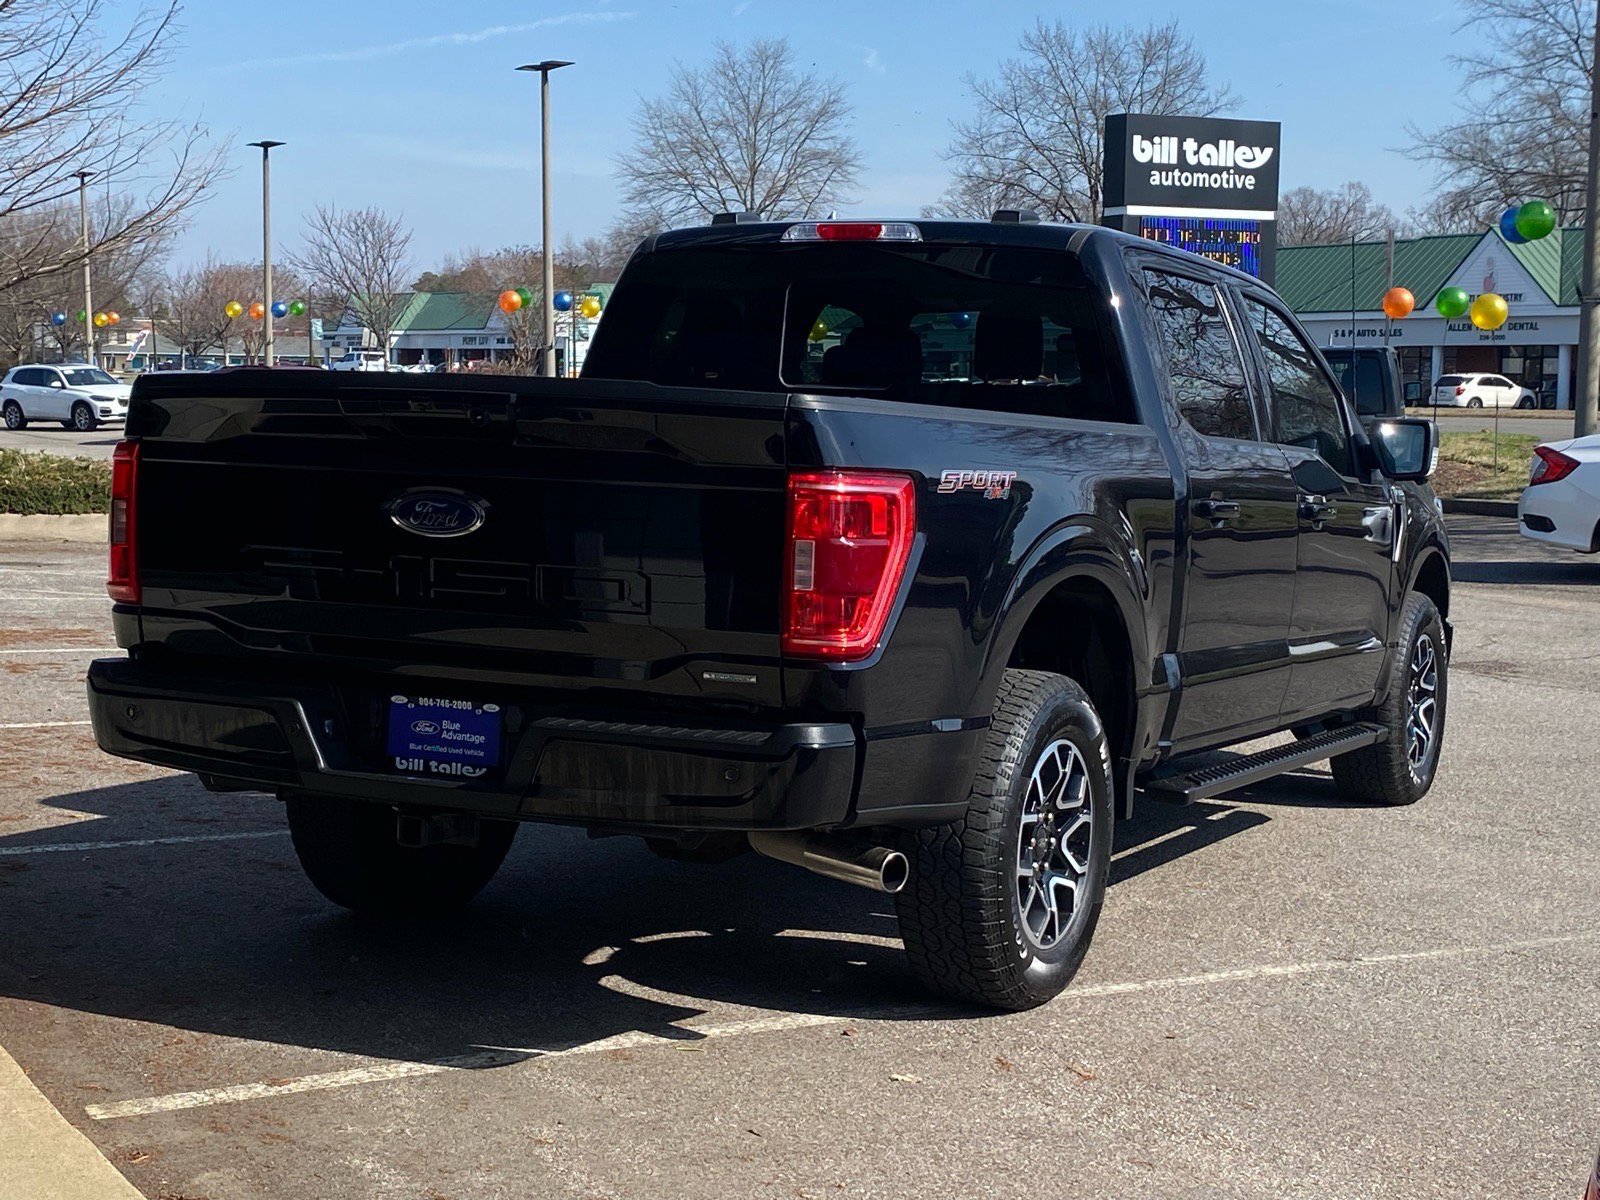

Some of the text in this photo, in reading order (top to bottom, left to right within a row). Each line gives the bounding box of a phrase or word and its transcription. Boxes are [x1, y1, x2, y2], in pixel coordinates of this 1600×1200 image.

[1132, 134, 1274, 169] bill talley
[1149, 169, 1256, 190] automotive
[1356, 328, 1377, 337] AUTO
[1448, 323, 1473, 332] ALLEN
[1508, 321, 1539, 331] DENTAL
[937, 469, 1018, 494] SPORT
[409, 500, 461, 528] Ford
[415, 719, 461, 733] Ford Blue
[441, 730, 486, 745] Advantage
[409, 742, 485, 757] Blue Certified Used Vehicle
[395, 756, 488, 778] bill talley
